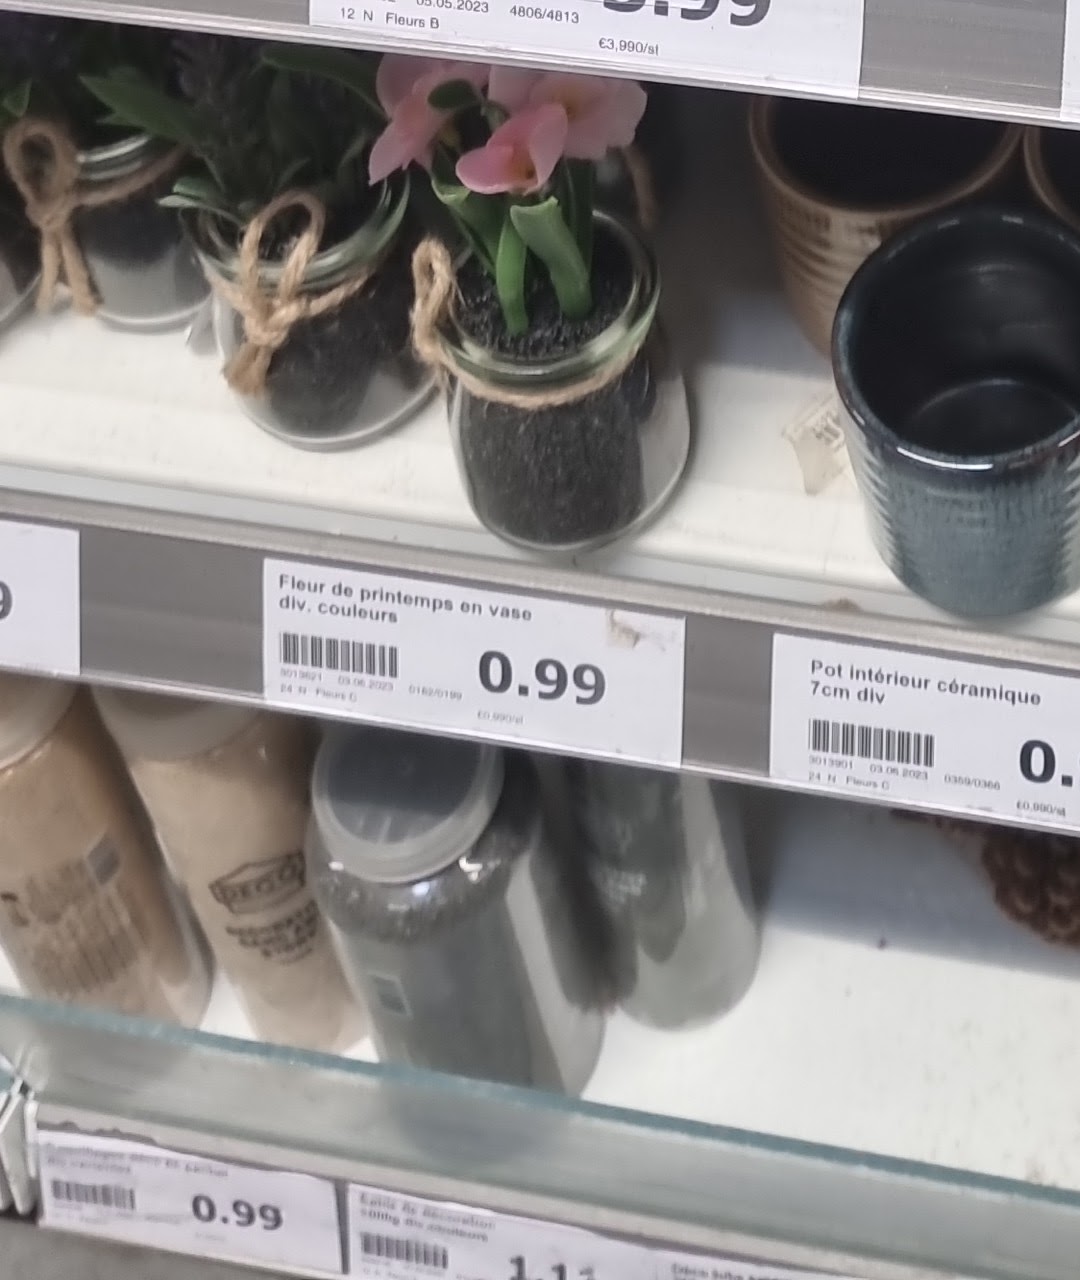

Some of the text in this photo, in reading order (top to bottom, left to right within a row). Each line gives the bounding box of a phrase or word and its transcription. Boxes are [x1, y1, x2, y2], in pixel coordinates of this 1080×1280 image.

[341, 7, 439, 29] 12 N Fleurs B
[510, 5, 579, 24] 4806/4813
[279, 574, 532, 621] Fleur de printemps en vase
[279, 595, 397, 623] div. couleurs
[479, 650, 605, 705] 0.99
[811, 659, 1041, 706] Pot intérieur céramique
[811, 680, 885, 704] 7cm div
[192, 1194, 283, 1230] 0.99
